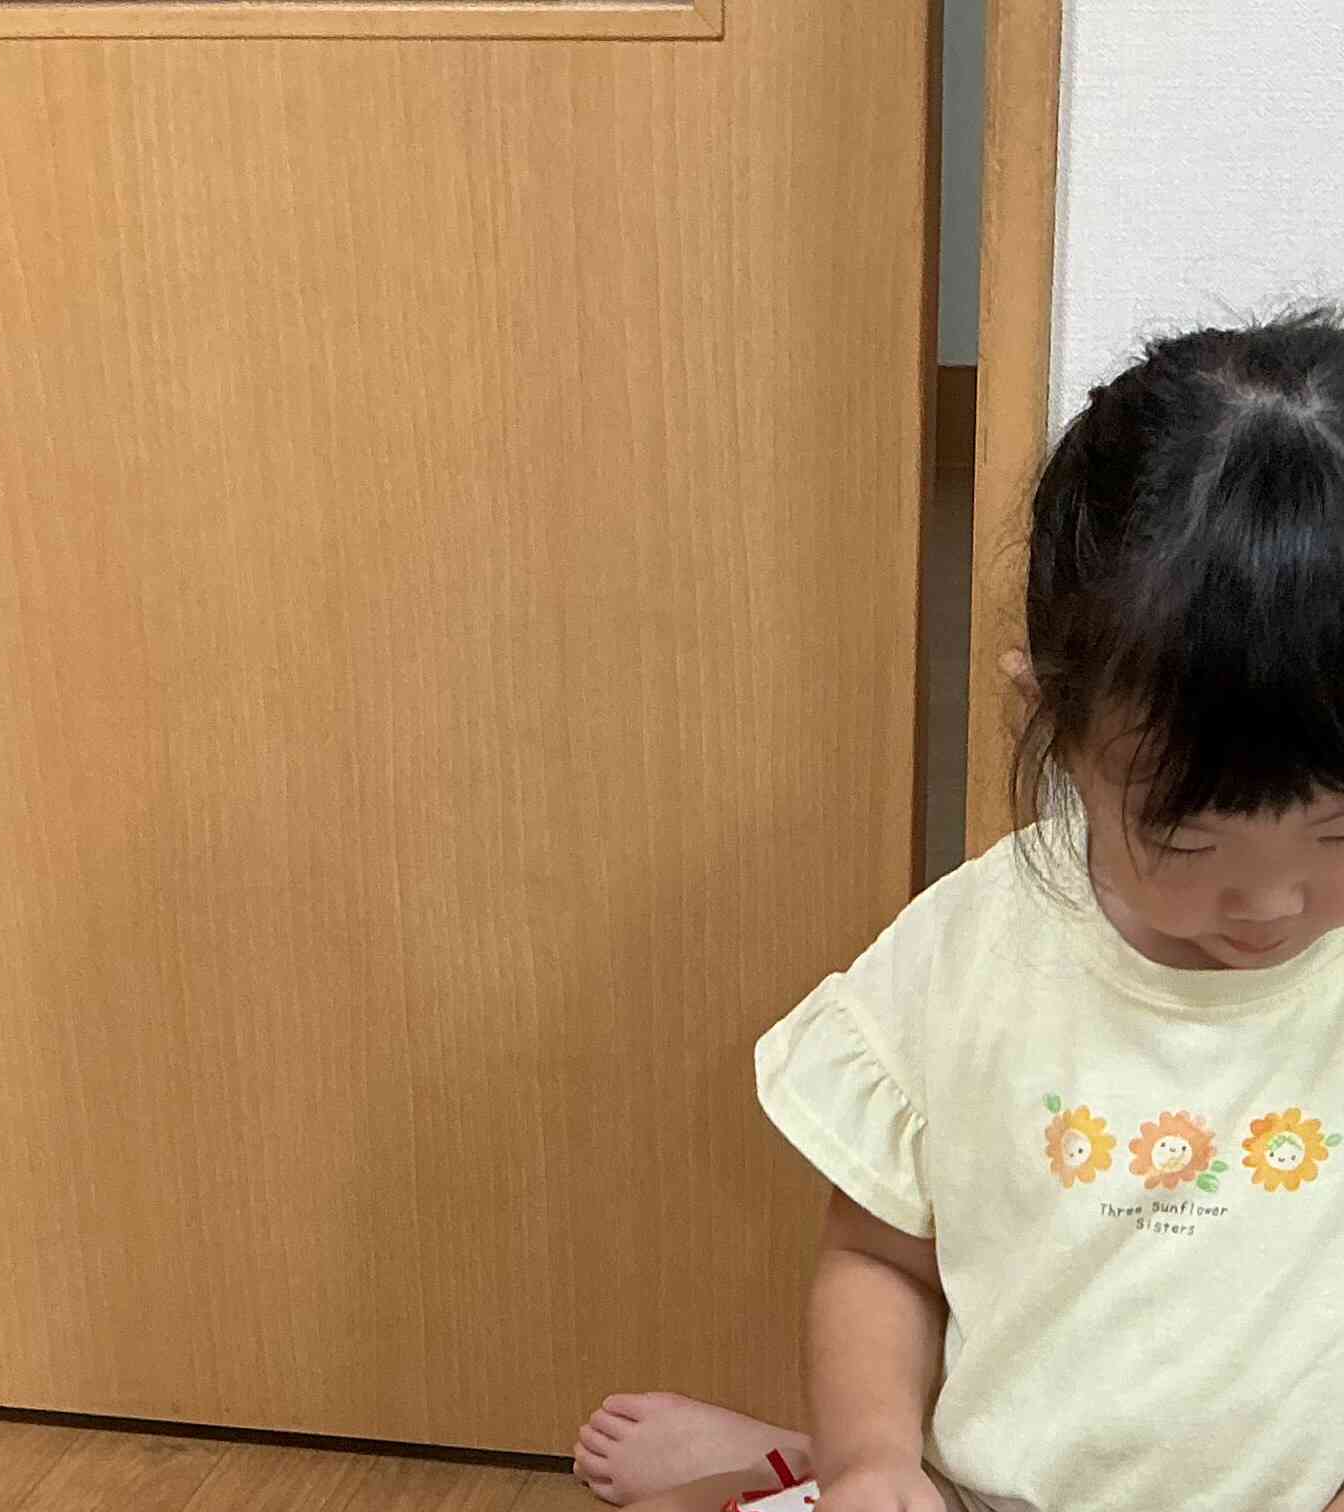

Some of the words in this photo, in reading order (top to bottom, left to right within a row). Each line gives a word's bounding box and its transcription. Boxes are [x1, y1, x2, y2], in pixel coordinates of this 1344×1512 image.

[1100, 1202, 1142, 1217] Three
[1152, 1200, 1229, 1217] Sunflower
[1136, 1217, 1195, 1236] Sisters
